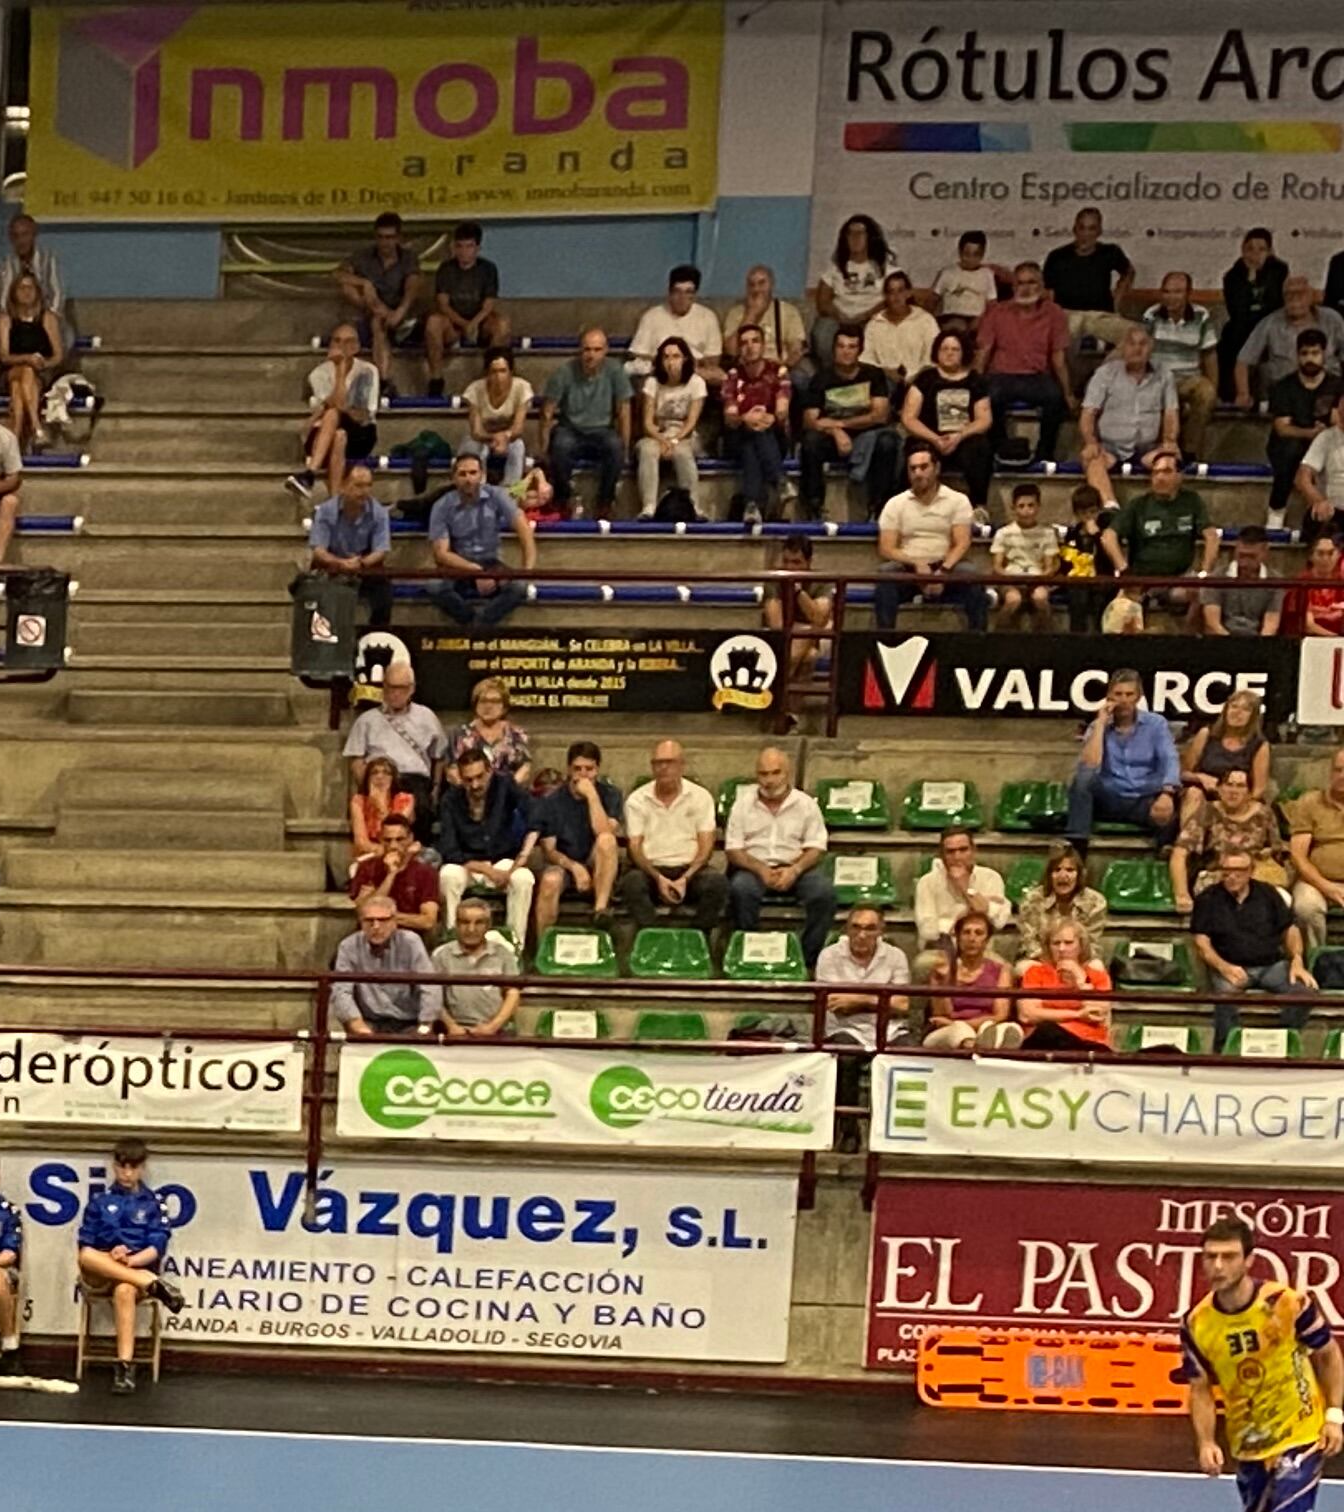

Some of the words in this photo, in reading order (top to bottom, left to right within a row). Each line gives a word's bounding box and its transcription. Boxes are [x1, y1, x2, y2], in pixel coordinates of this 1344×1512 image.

[846, 26, 1170, 102] Rótulos
[402, 141, 690, 178] aranda
[909, 172, 1009, 201] Centro
[1021, 171, 1221, 207] Especializado
[1232, 172, 1269, 202] de
[955, 668, 1269, 714] VALCRCE
[249, 1168, 640, 1259] Vázquez,
[666, 1204, 769, 1250] S.L.
[1157, 1198, 1332, 1239] MESÓN
[163, 1256, 376, 1287] ANEAMIENTO
[407, 1264, 644, 1296] CALEFACCIÓN
[876, 1236, 985, 1313] EL
[320, 1293, 370, 1316] DE
[387, 1295, 541, 1323] COCINA
[555, 1303, 577, 1326] Y
[594, 1302, 708, 1330] BAÑO
[259, 1319, 351, 1340] BURGOS
[370, 1325, 507, 1346] VALLADOLID
[525, 1329, 624, 1351] SEGOVIA
[1225, 1329, 1260, 1356] 33
